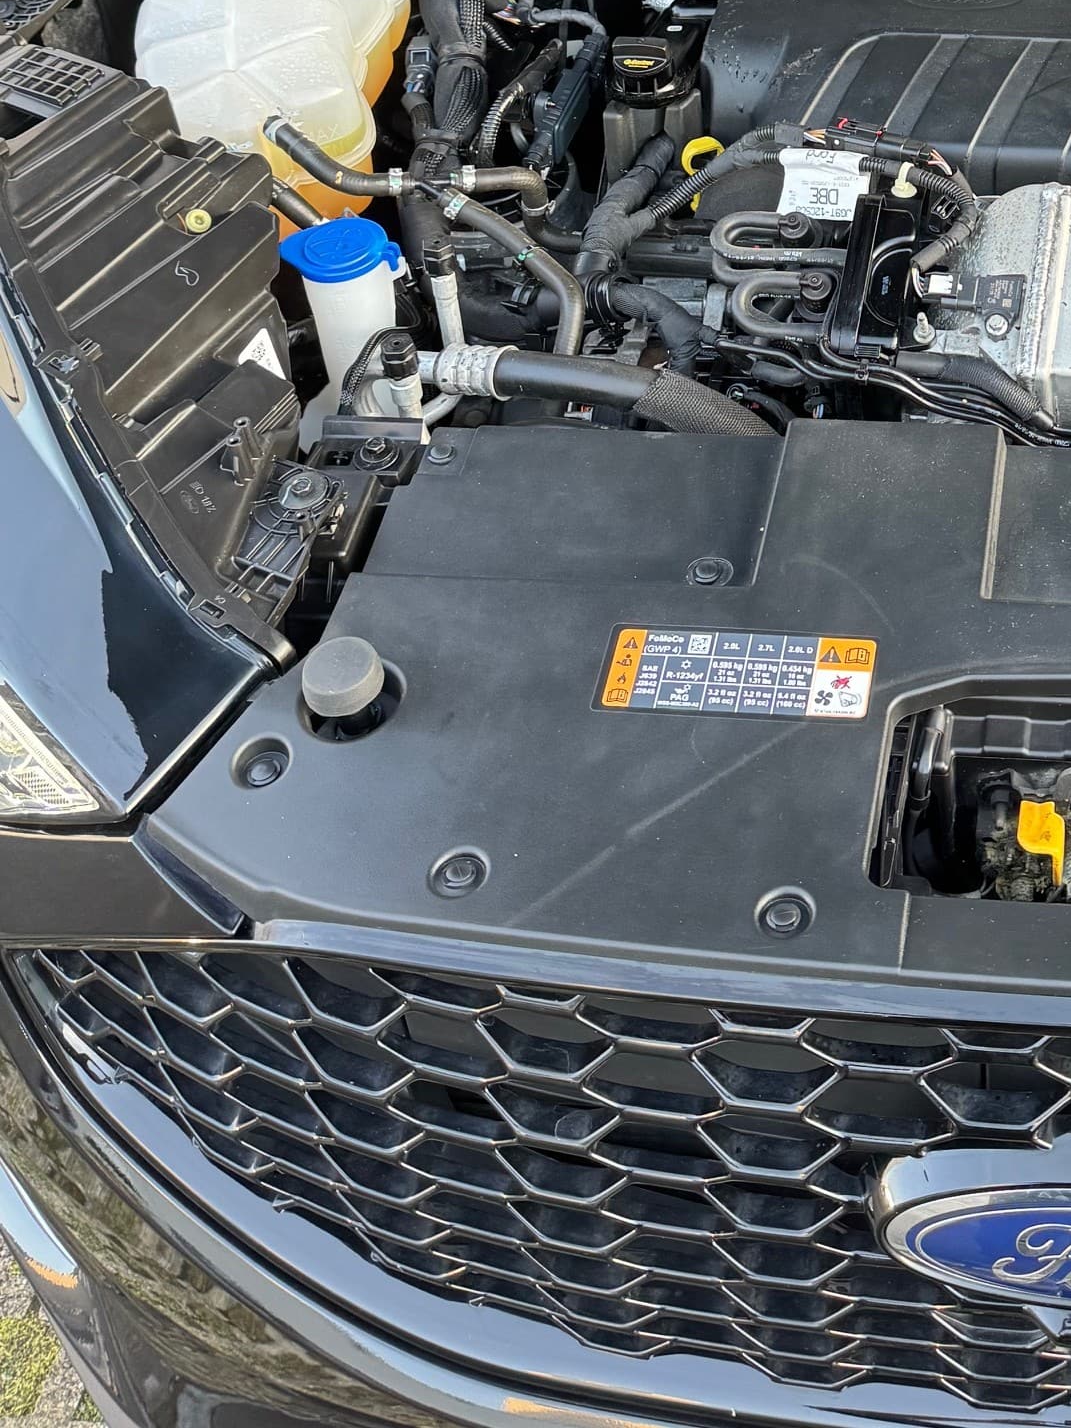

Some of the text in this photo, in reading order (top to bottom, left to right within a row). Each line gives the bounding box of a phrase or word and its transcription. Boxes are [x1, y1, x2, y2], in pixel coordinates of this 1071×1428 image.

[809, 187, 838, 205] DBE
[648, 634, 685, 643] FoMoCo
[644, 645, 682, 655] (GWP 4)
[758, 644, 775, 652] 2.7L
[734, 662, 743, 671] kg
[768, 664, 778, 673] kg
[803, 666, 812, 675] kg
[666, 671, 704, 682] R-1234yf
[669, 694, 689, 702] PAG
